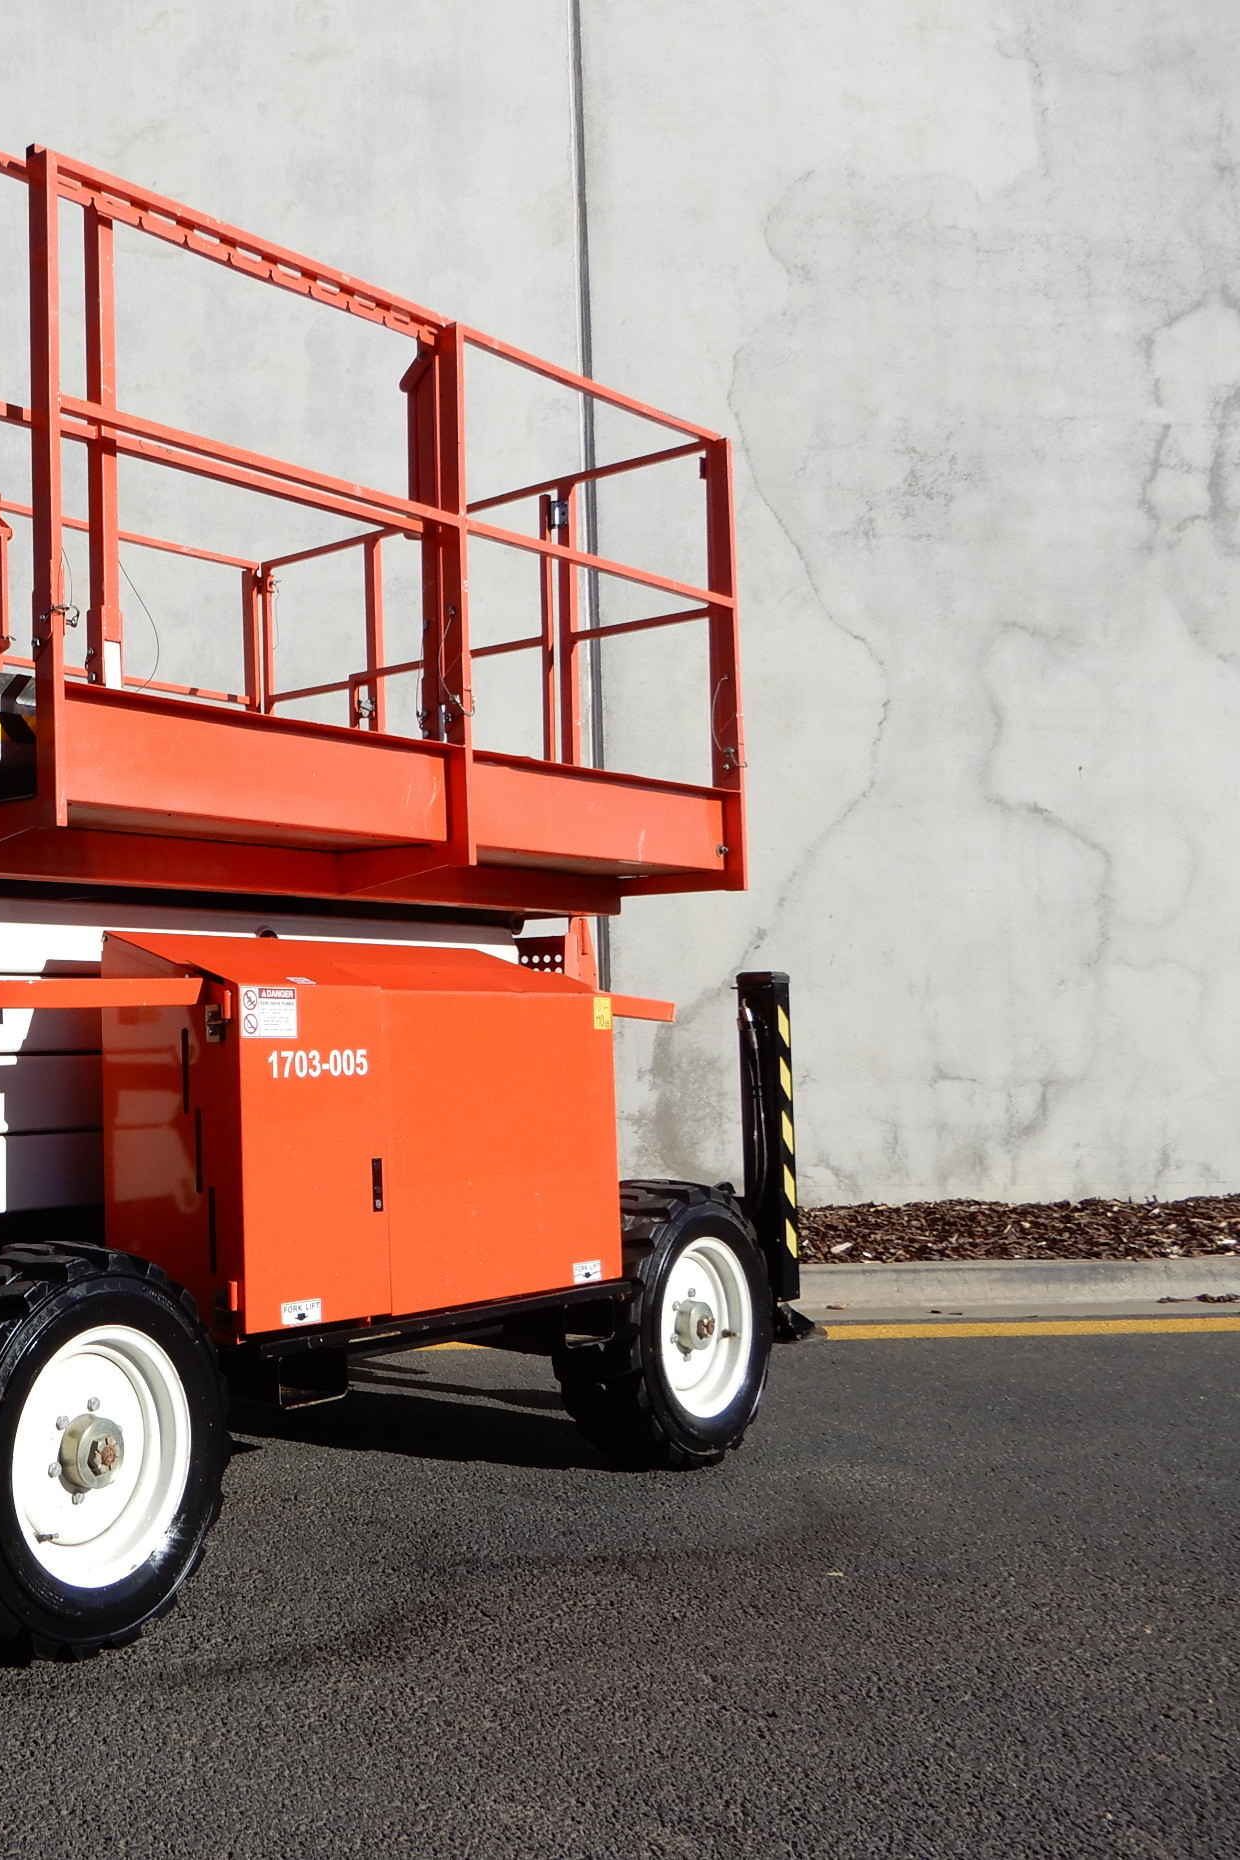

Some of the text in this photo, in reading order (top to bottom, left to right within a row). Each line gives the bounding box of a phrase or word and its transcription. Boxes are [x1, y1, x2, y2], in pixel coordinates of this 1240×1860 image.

[266, 990, 294, 998] DANGER
[267, 1049, 368, 1078] 1703-005
[284, 1302, 320, 1313] FORK LIFT
